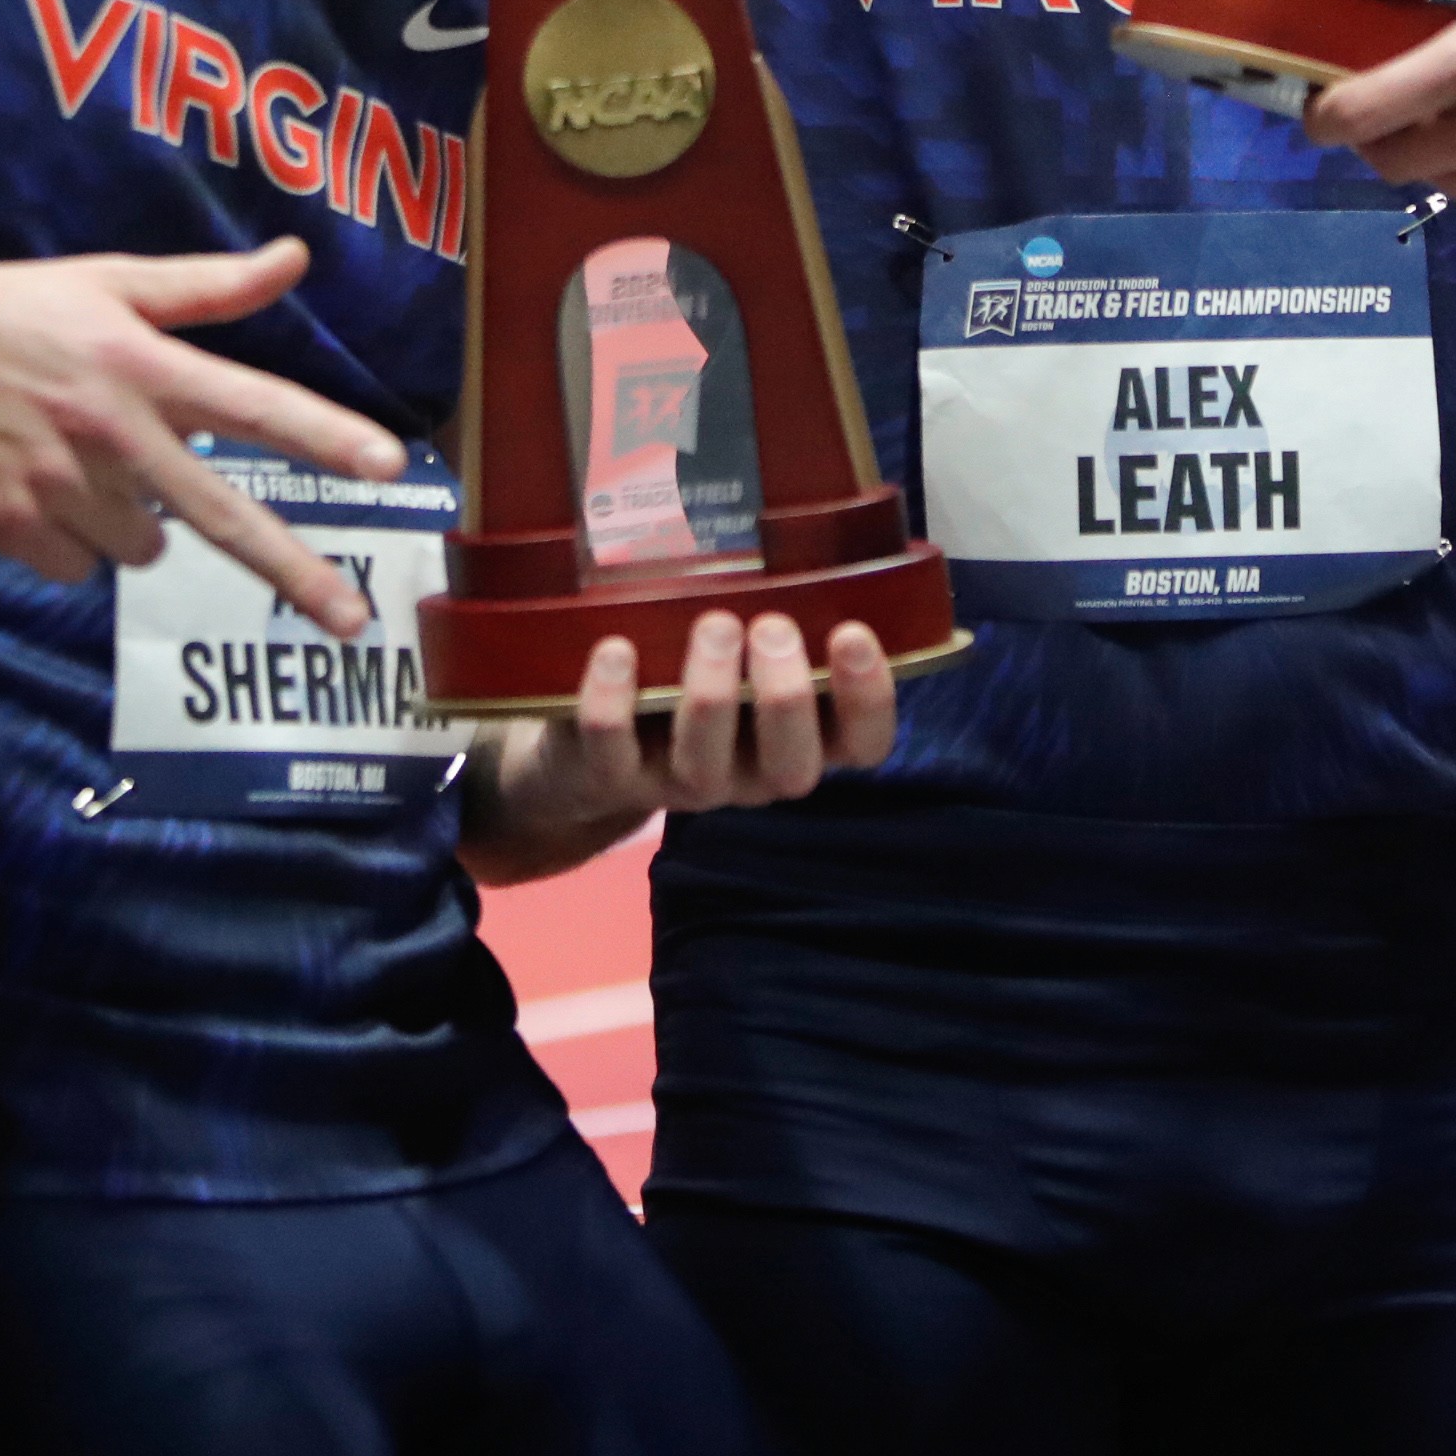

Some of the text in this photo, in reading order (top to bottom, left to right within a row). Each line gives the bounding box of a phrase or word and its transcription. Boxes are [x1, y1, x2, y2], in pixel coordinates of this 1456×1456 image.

[548, 65, 704, 132] NCAA
[1023, 286, 1392, 320] TRACK & FIELD CHAMPIONSHIPS
[1026, 281, 1055, 292] 2024
[1057, 280, 1108, 292] DIVISION
[1118, 278, 1159, 290] INDOOR
[1021, 322, 1054, 332] BOSTON
[1113, 364, 1262, 431] ALEX
[1077, 451, 1301, 535] LEATH
[1125, 567, 1261, 595] BOSTON, MA
[181, 641, 451, 732] SHERMA
